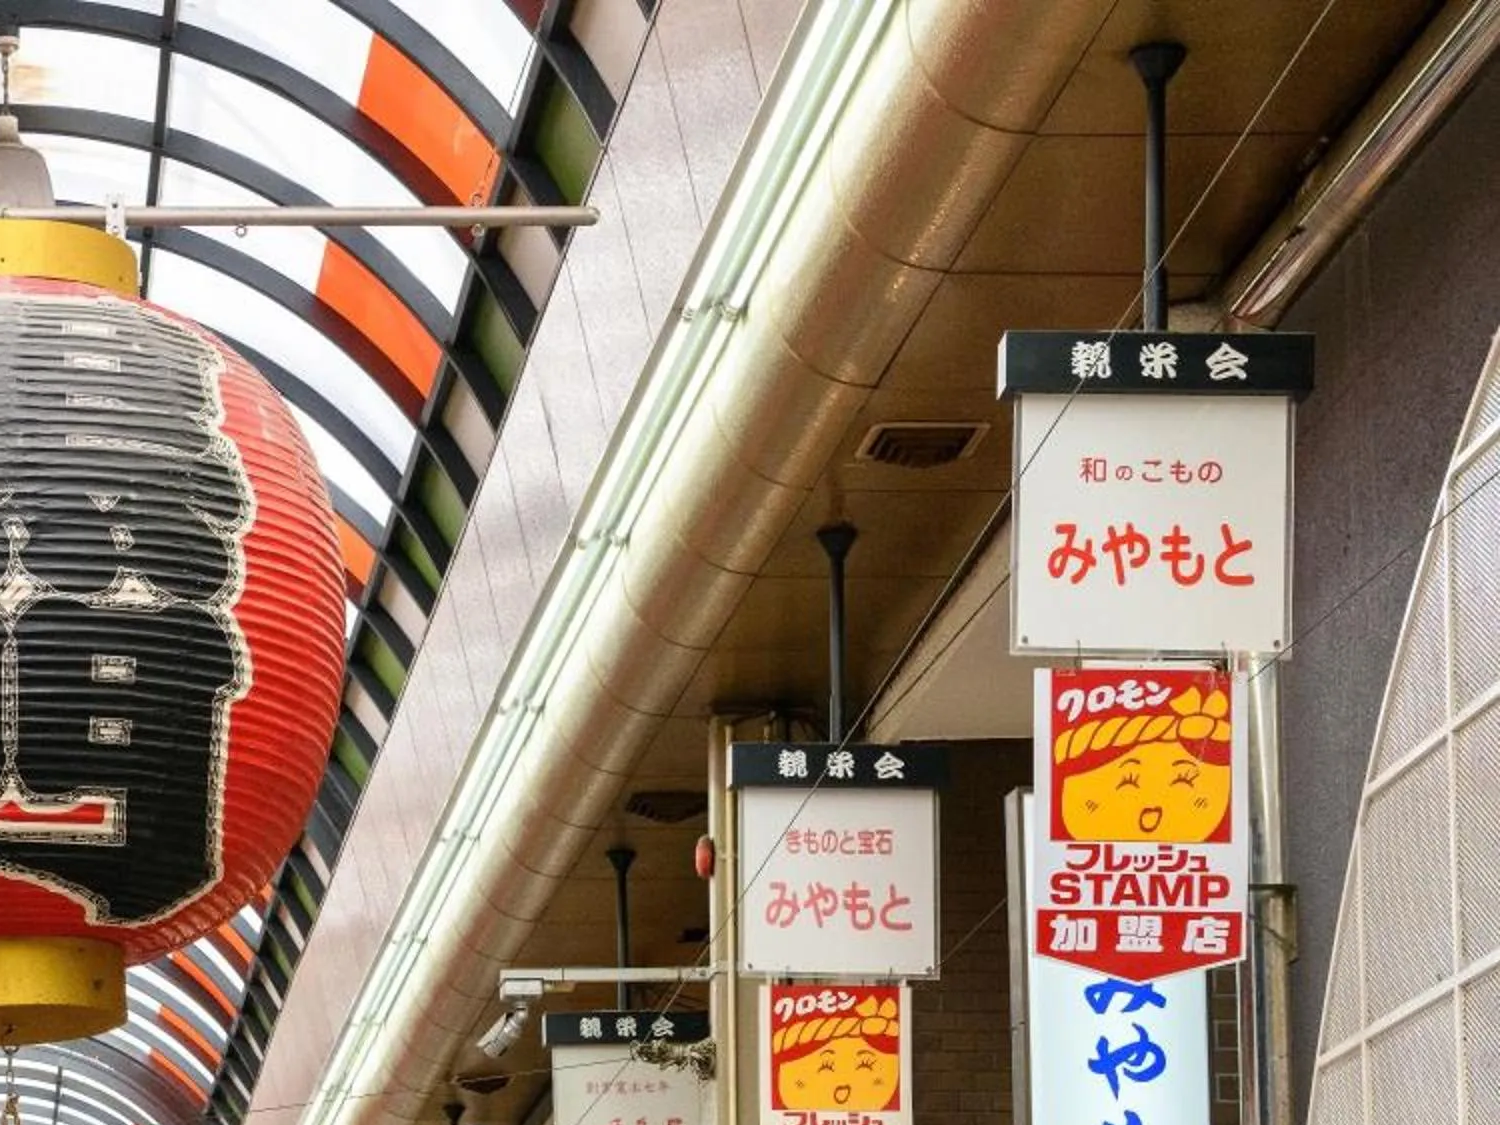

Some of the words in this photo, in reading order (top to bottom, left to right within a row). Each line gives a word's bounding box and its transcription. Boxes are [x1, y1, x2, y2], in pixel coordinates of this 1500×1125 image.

[1079, 456, 1224, 484] 和のこもの
[1047, 521, 1256, 587] みやもと
[1056, 680, 1173, 722] クロモン
[784, 828, 894, 857] きものと宝石
[1064, 844, 1209, 874] フレッシュ
[764, 879, 914, 932] みやもと
[1050, 873, 1231, 907] STAMP
[1049, 914, 1231, 954] 加盟店
[773, 990, 857, 1019] クロモン
